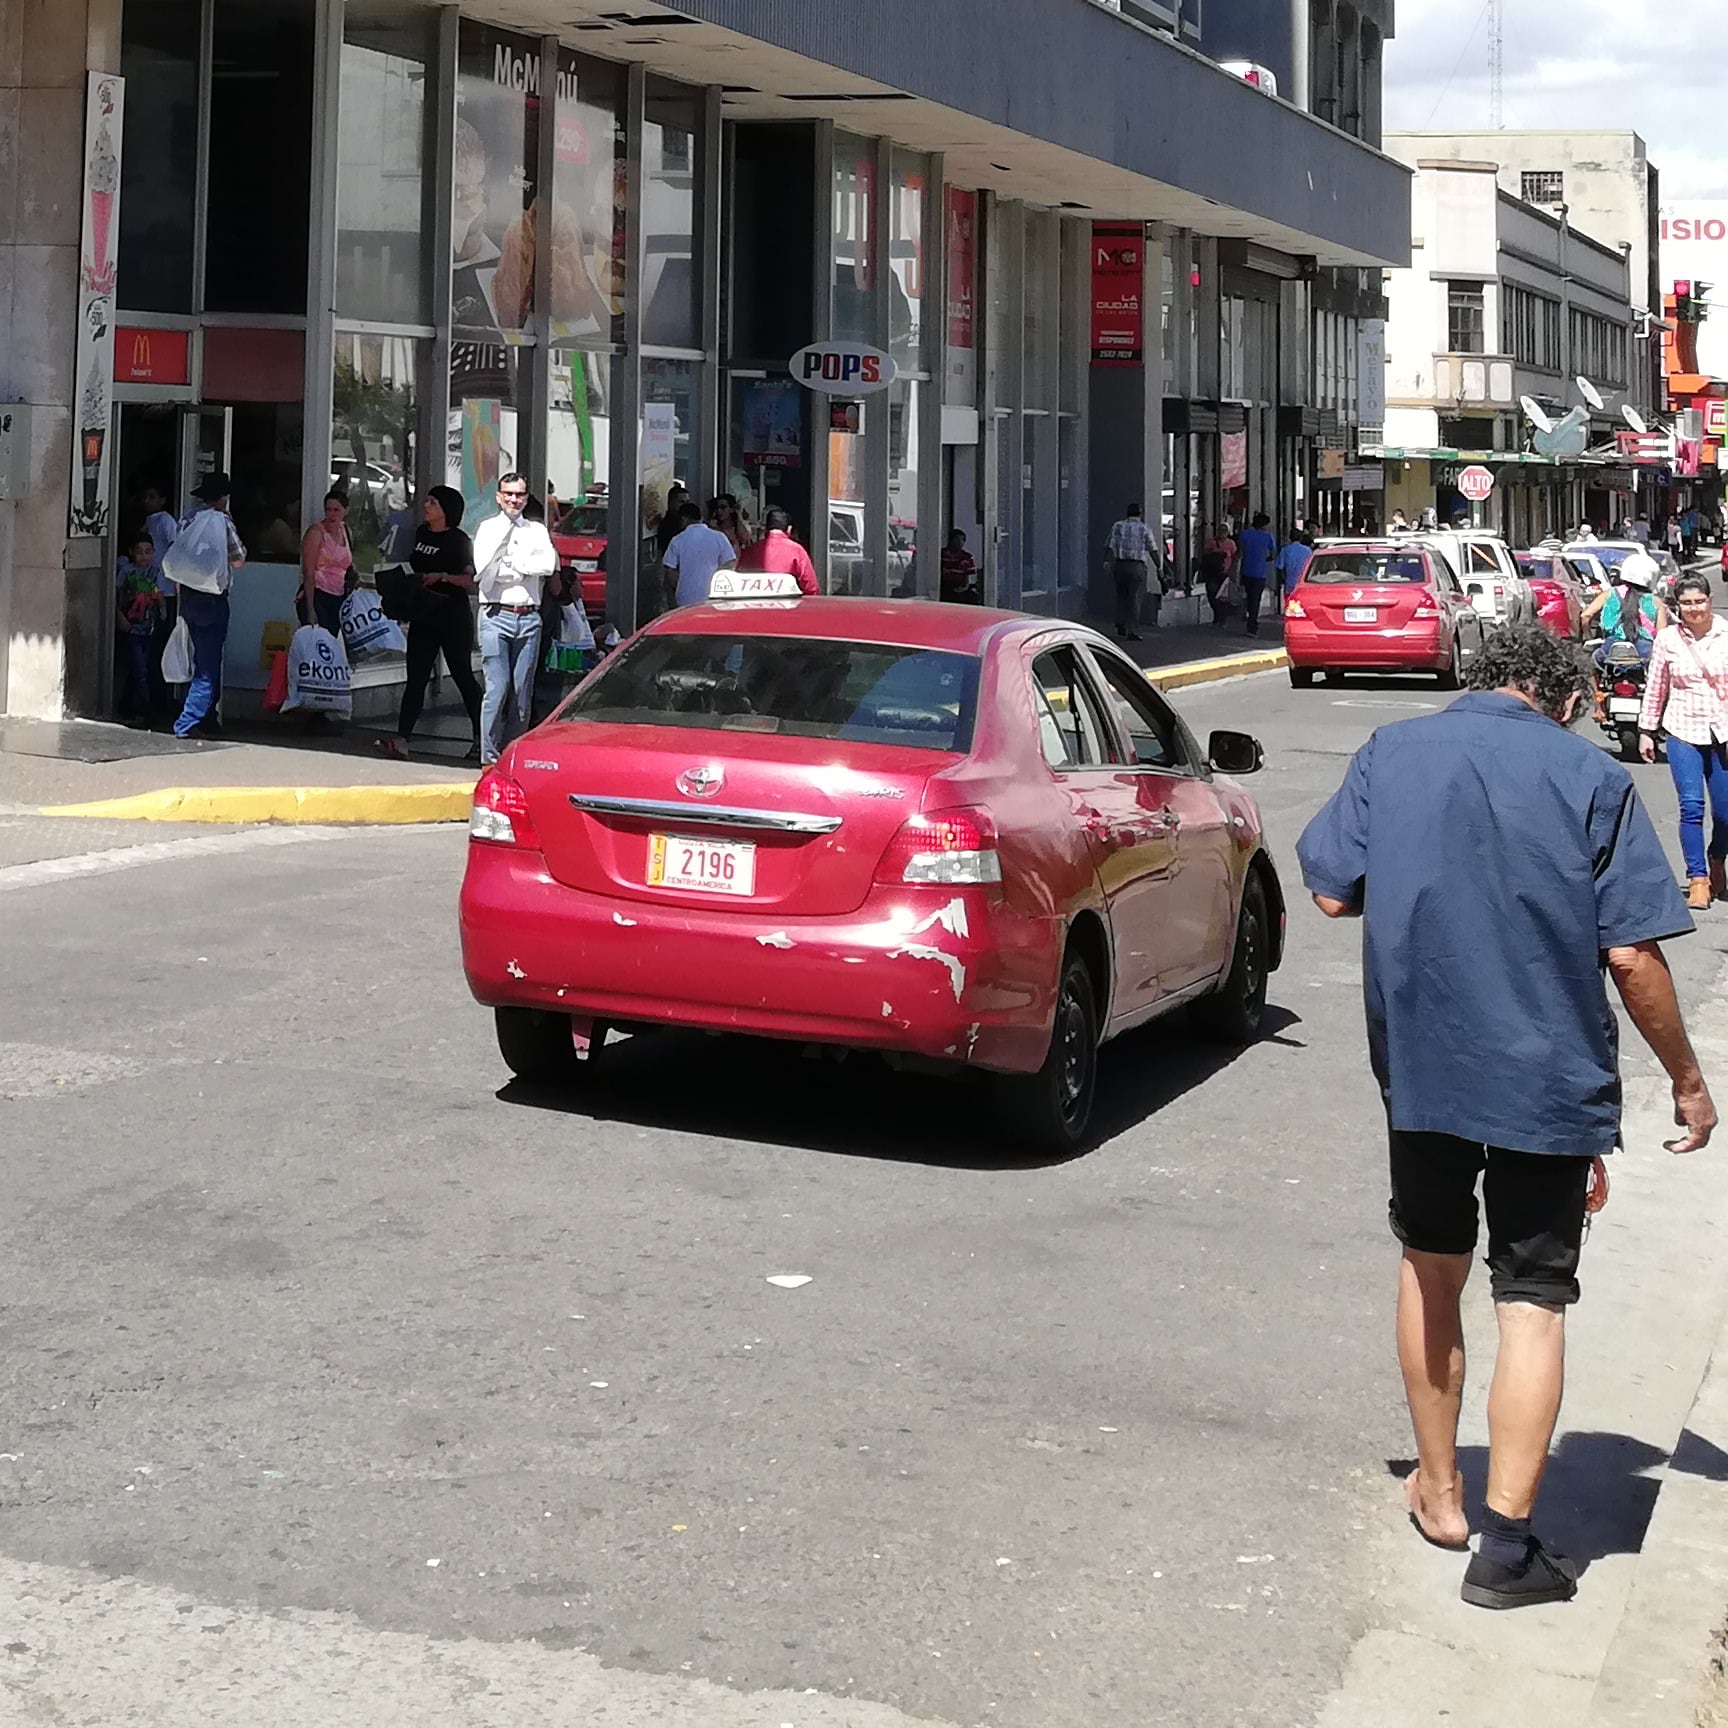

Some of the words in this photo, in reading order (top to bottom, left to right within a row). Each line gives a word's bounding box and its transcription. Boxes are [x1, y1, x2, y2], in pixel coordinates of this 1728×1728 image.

[494, 44, 578, 104] McMnú
[1096, 301, 1138, 309] CIUDAD
[1121, 294, 1138, 302] LA
[803, 352, 880, 383] POPS
[1462, 474, 1491, 491] ALTO
[741, 578, 784, 593] TAXI
[681, 849, 736, 879] 2196
[667, 875, 732, 890] CENTROAMERICA
